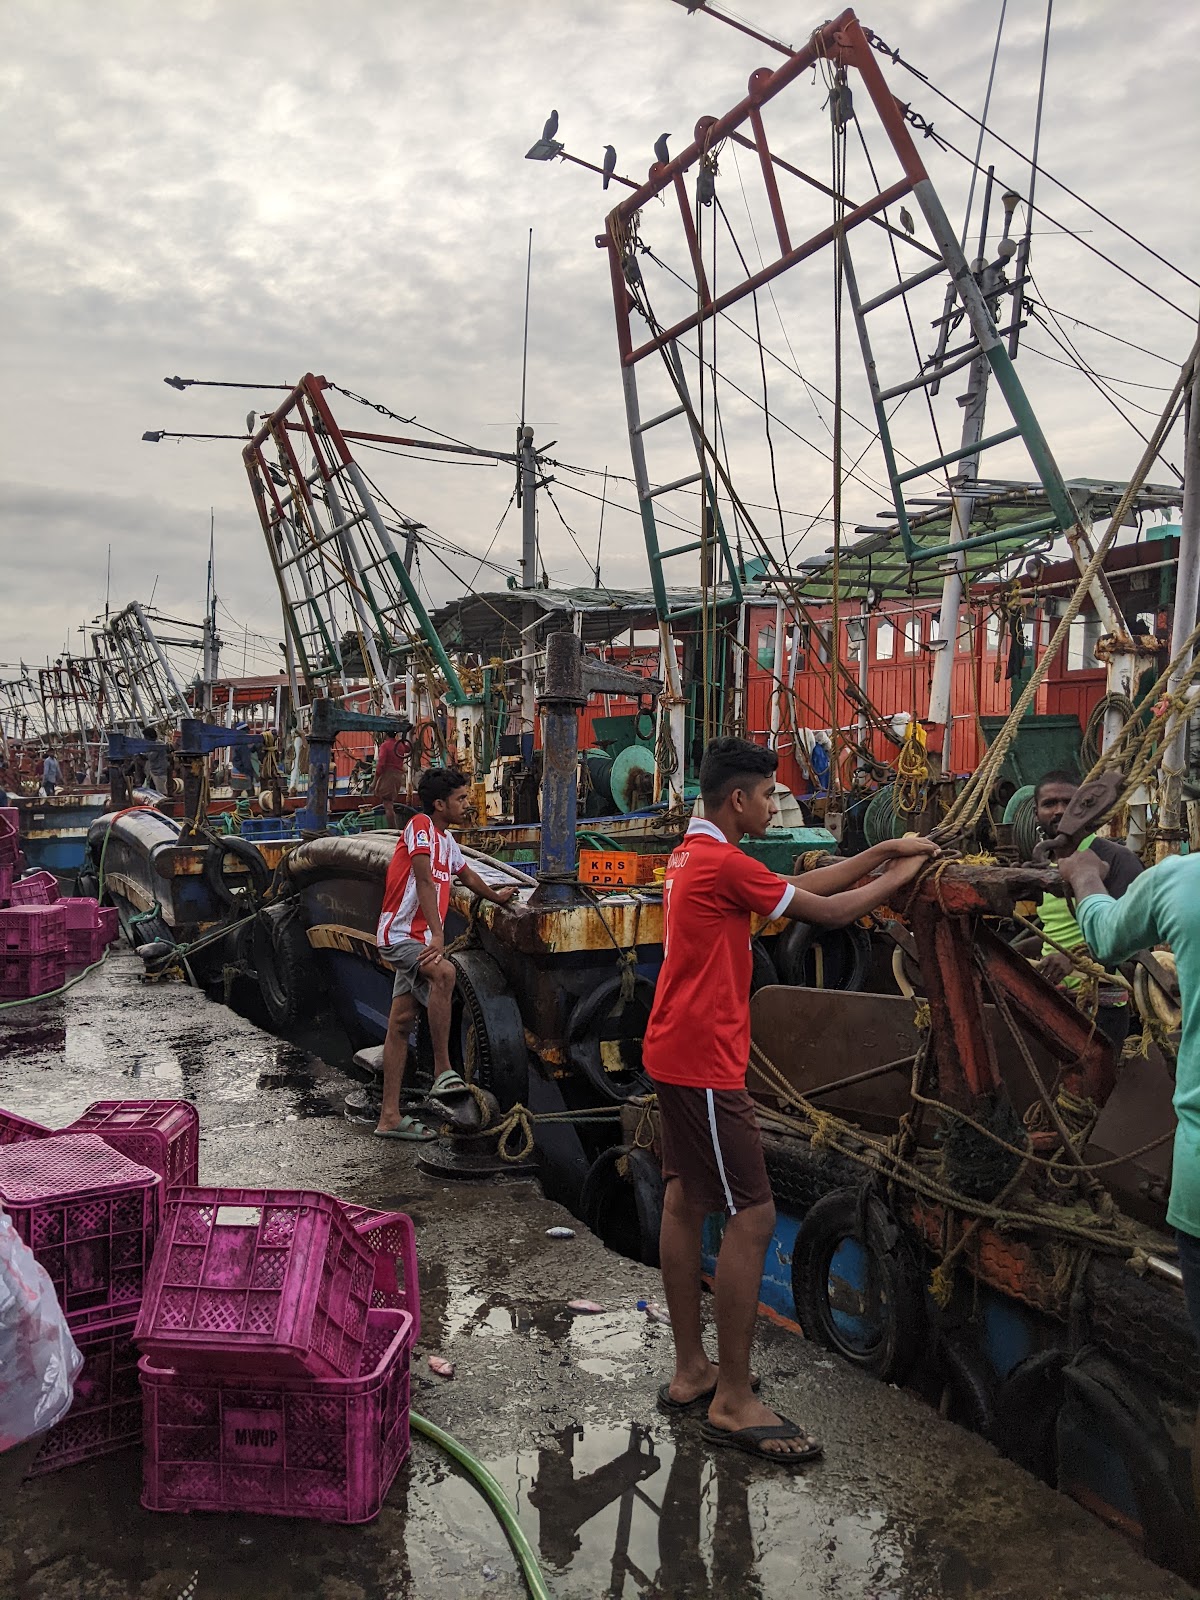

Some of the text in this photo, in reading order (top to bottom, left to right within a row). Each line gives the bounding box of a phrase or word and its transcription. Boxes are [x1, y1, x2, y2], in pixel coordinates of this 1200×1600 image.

[592, 861, 625, 870] KRS
[592, 875, 624, 884] PPA
[664, 879, 674, 960] 7
